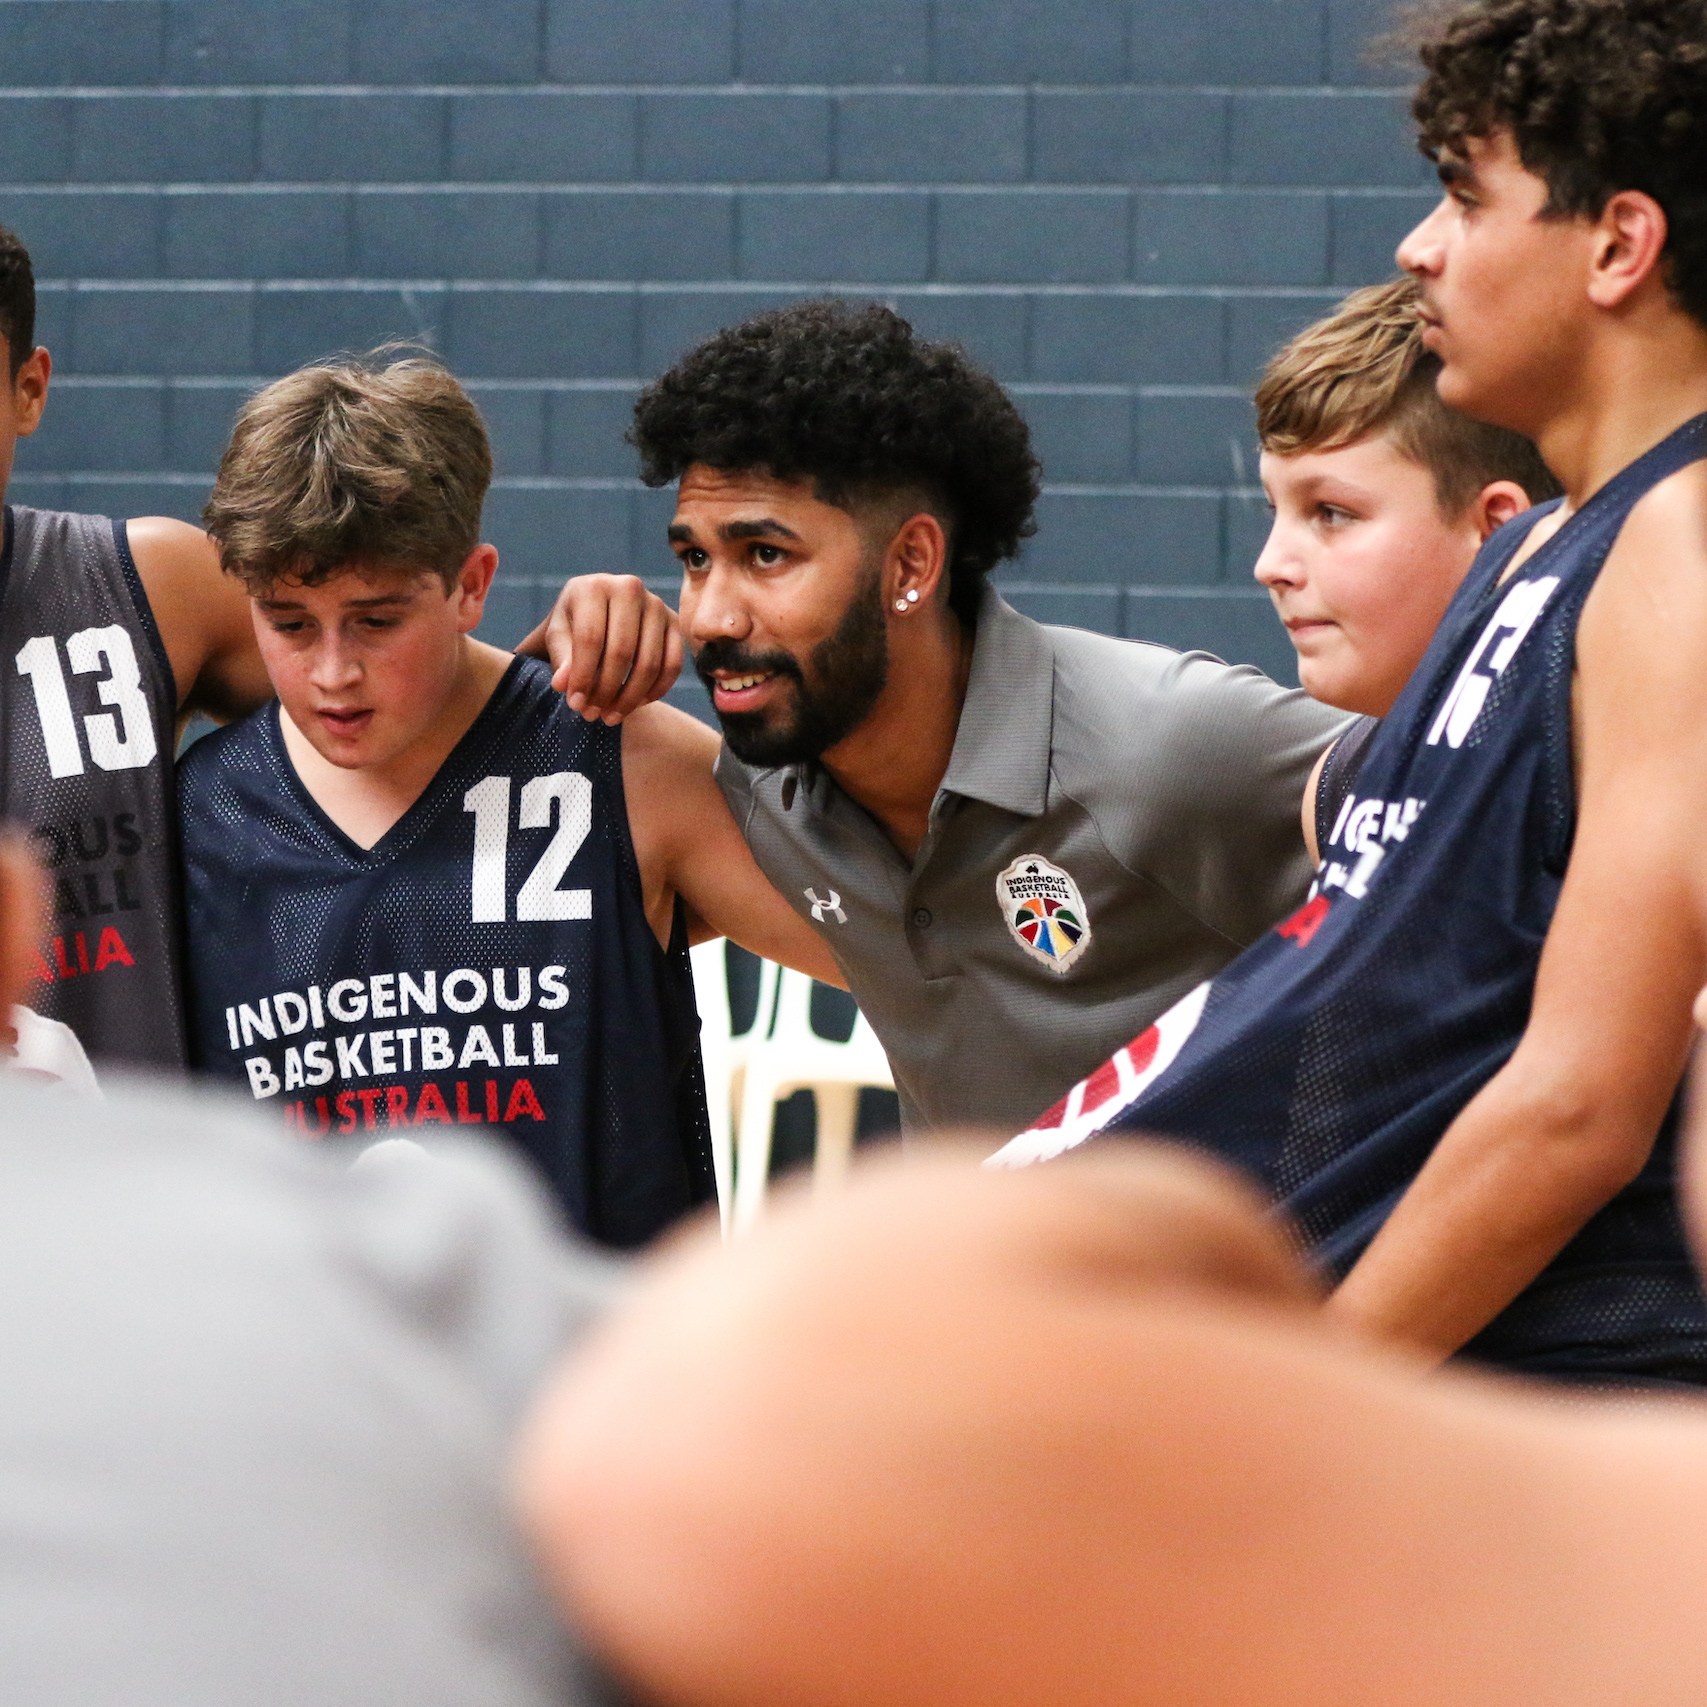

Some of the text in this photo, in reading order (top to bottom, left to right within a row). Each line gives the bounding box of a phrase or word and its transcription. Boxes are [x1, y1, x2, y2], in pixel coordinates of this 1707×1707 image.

[15, 624, 157, 779] 13
[463, 772, 592, 923] 12
[1006, 876, 1065, 885] INDIGENOUS
[1009, 884, 1068, 894] BASKETBALL
[225, 965, 570, 1050] INDIGENOUS
[245, 1022, 559, 1100] BASKETBALL
[284, 1079, 546, 1140] USTRALIA
